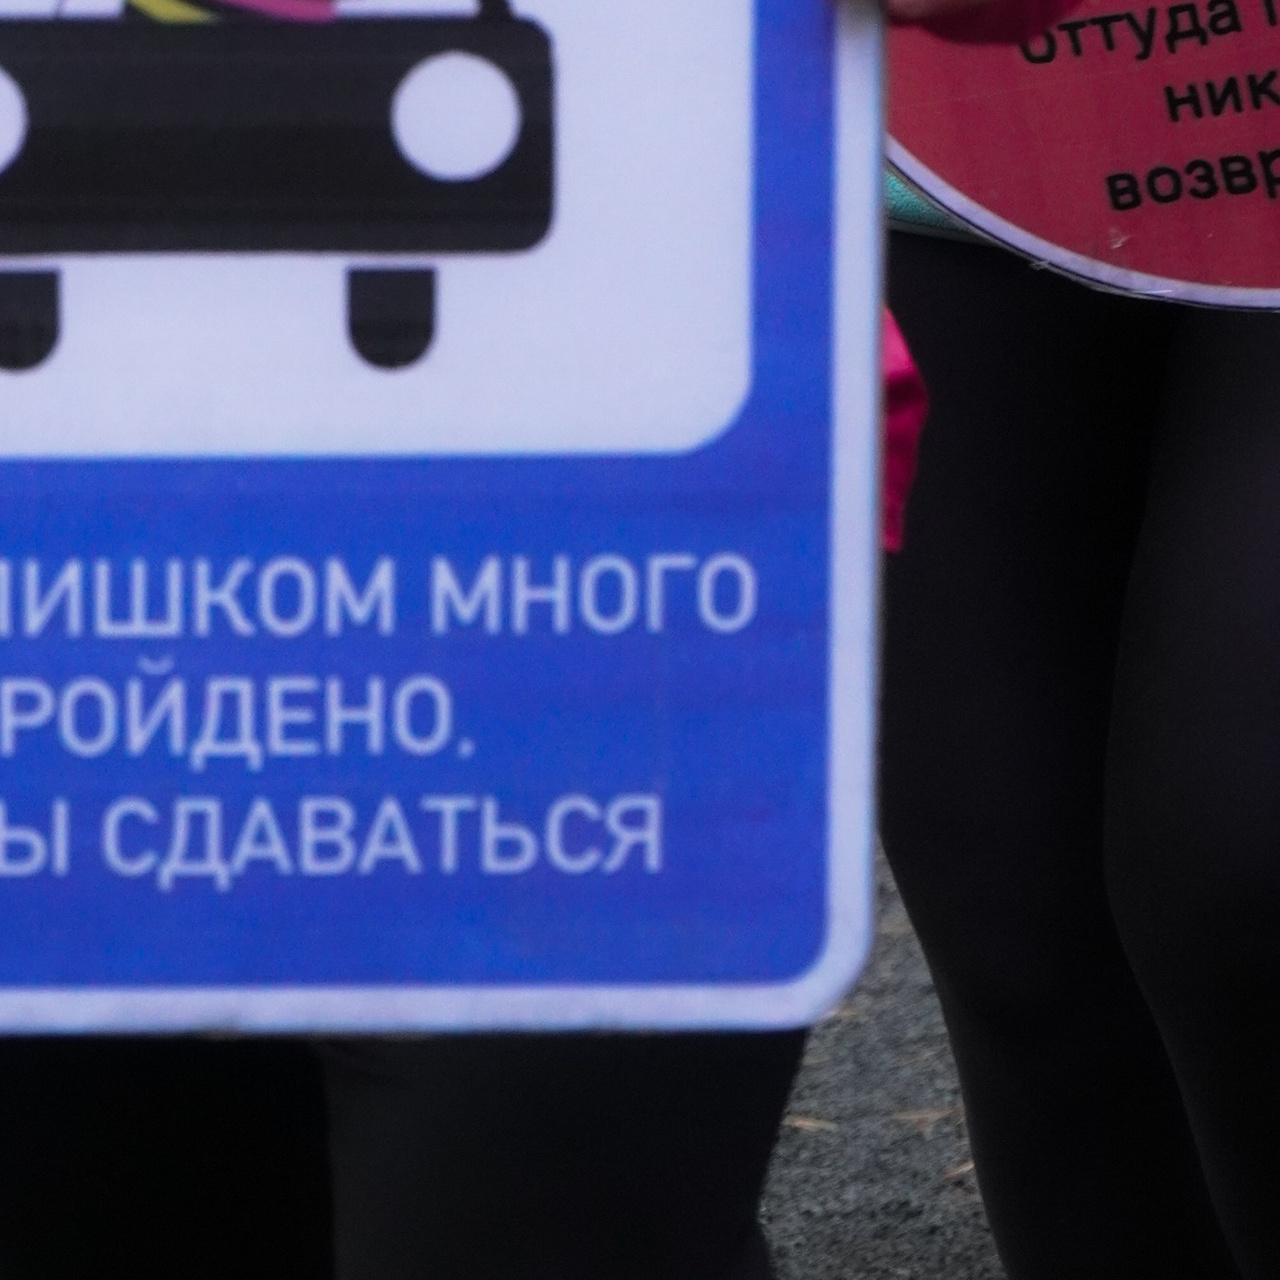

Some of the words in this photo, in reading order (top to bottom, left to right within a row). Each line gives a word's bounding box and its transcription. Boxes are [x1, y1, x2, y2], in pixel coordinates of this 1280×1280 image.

[1163, 69, 1280, 123] ник
[430, 552, 758, 634] МНОГО
[100, 793, 663, 890] СДАВАТЬСЯ
